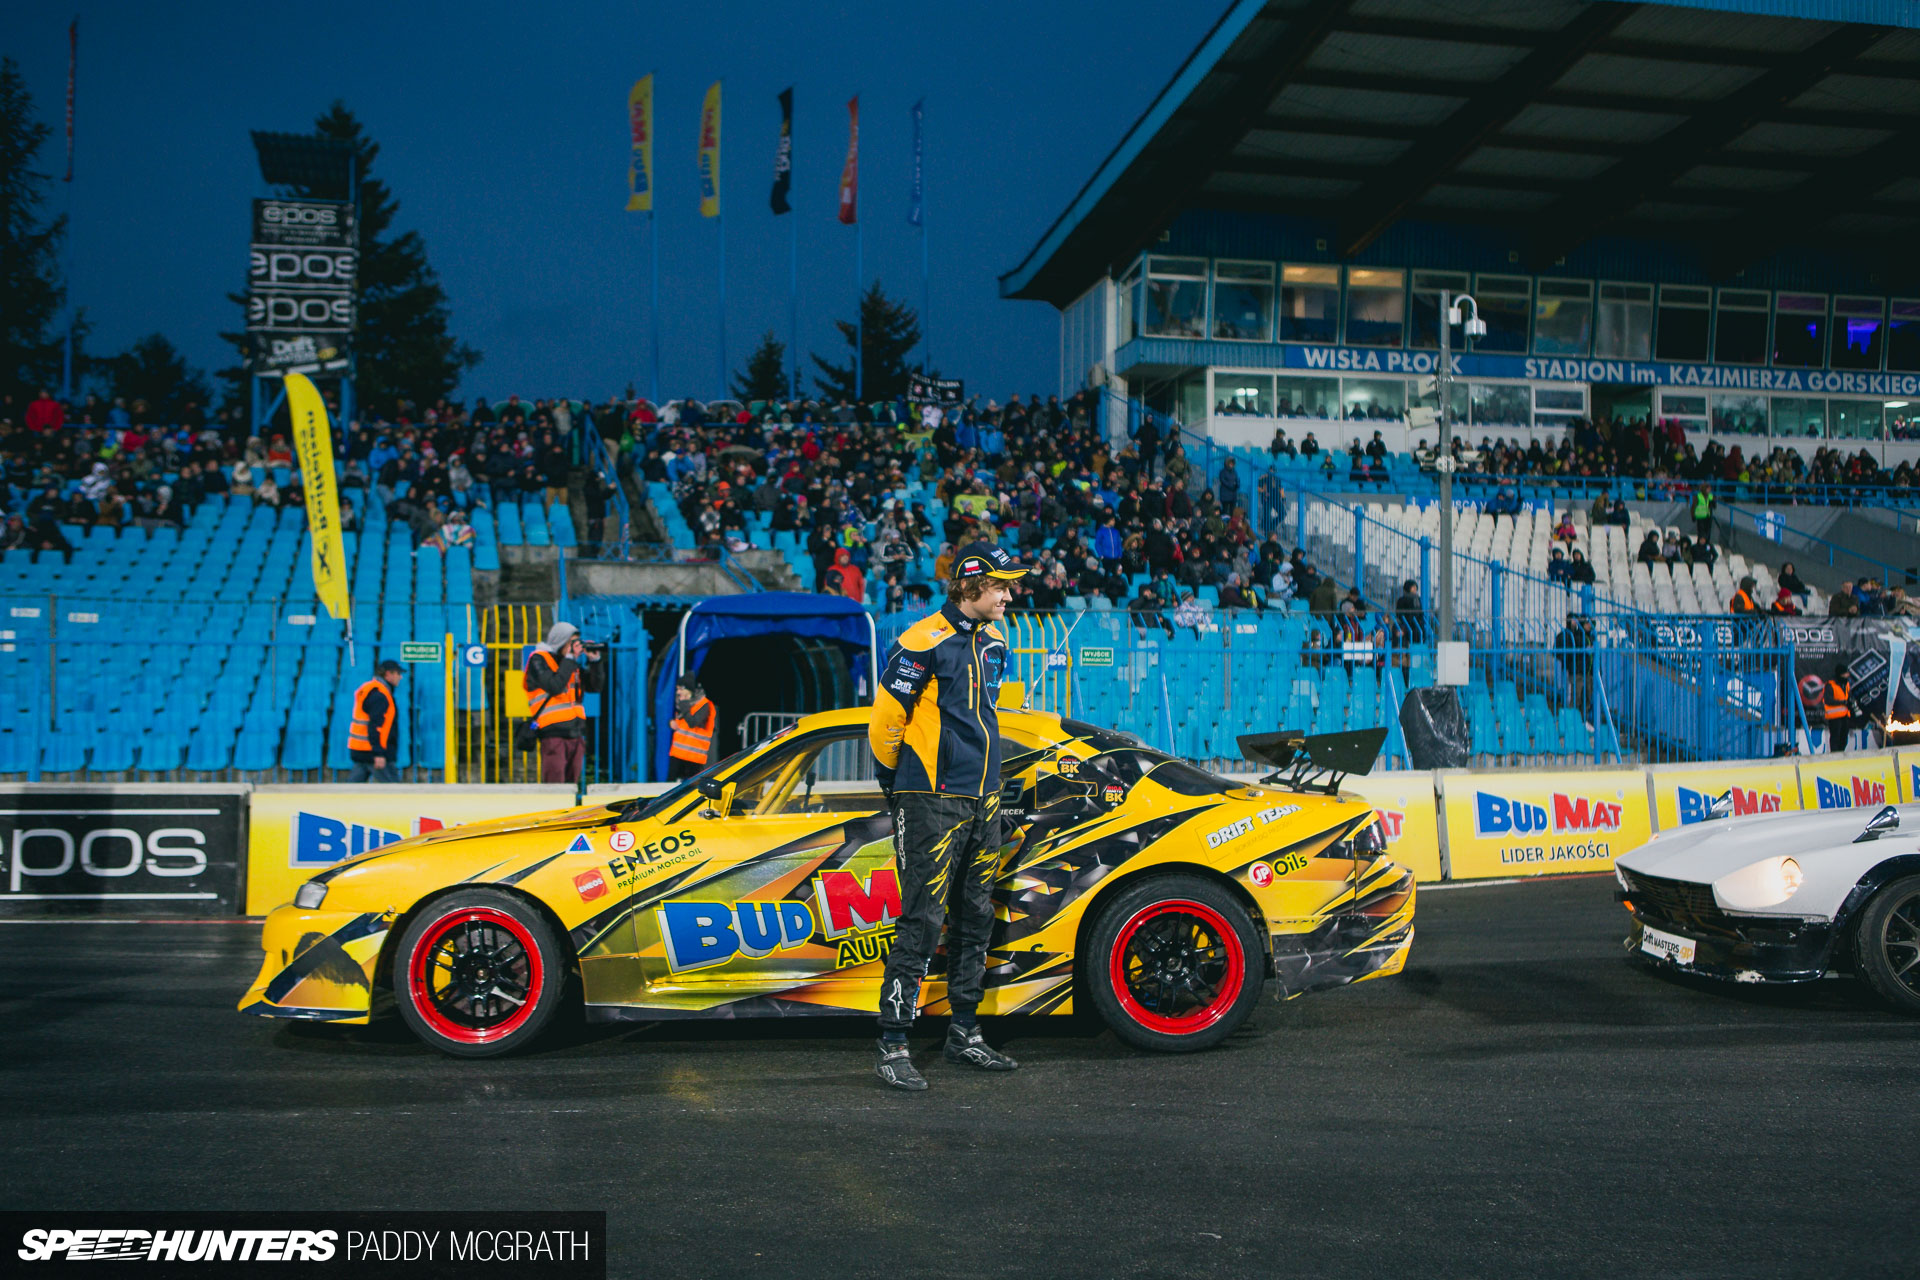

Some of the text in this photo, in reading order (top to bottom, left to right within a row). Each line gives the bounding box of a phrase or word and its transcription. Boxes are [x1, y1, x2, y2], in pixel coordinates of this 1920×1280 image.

[263, 206, 337, 225] epos
[1303, 348, 1381, 370] WISŁA
[1525, 358, 1624, 382] STADION
[1630, 363, 1662, 383] im.
[1669, 365, 1802, 390] KAZIMIERZA
[1807, 368, 1920, 394] GÓRSKIEG
[466, 646, 485, 665] G
[1048, 653, 1067, 666] SR
[1060, 763, 1080, 774] BK
[1105, 792, 1124, 802] BK
[1732, 786, 1781, 817] MAT
[1816, 776, 1851, 809] BUD
[1852, 775, 1886, 807] MAT
[1206, 804, 1303, 849] DRIFT TEAM
[1375, 810, 1404, 838] AT
[1475, 791, 1622, 836] BUD MAT
[0, 828, 207, 891] pos
[608, 829, 696, 879] ENEOS
[1501, 840, 1610, 863] LIDER JAKOŚCI
[617, 847, 702, 889] PREMIUM MOTOR OIL
[1255, 854, 1308, 881] JP Oils
[578, 878, 604, 893] ENEOS
[659, 901, 814, 972] BUD
[838, 934, 897, 967] AUT
